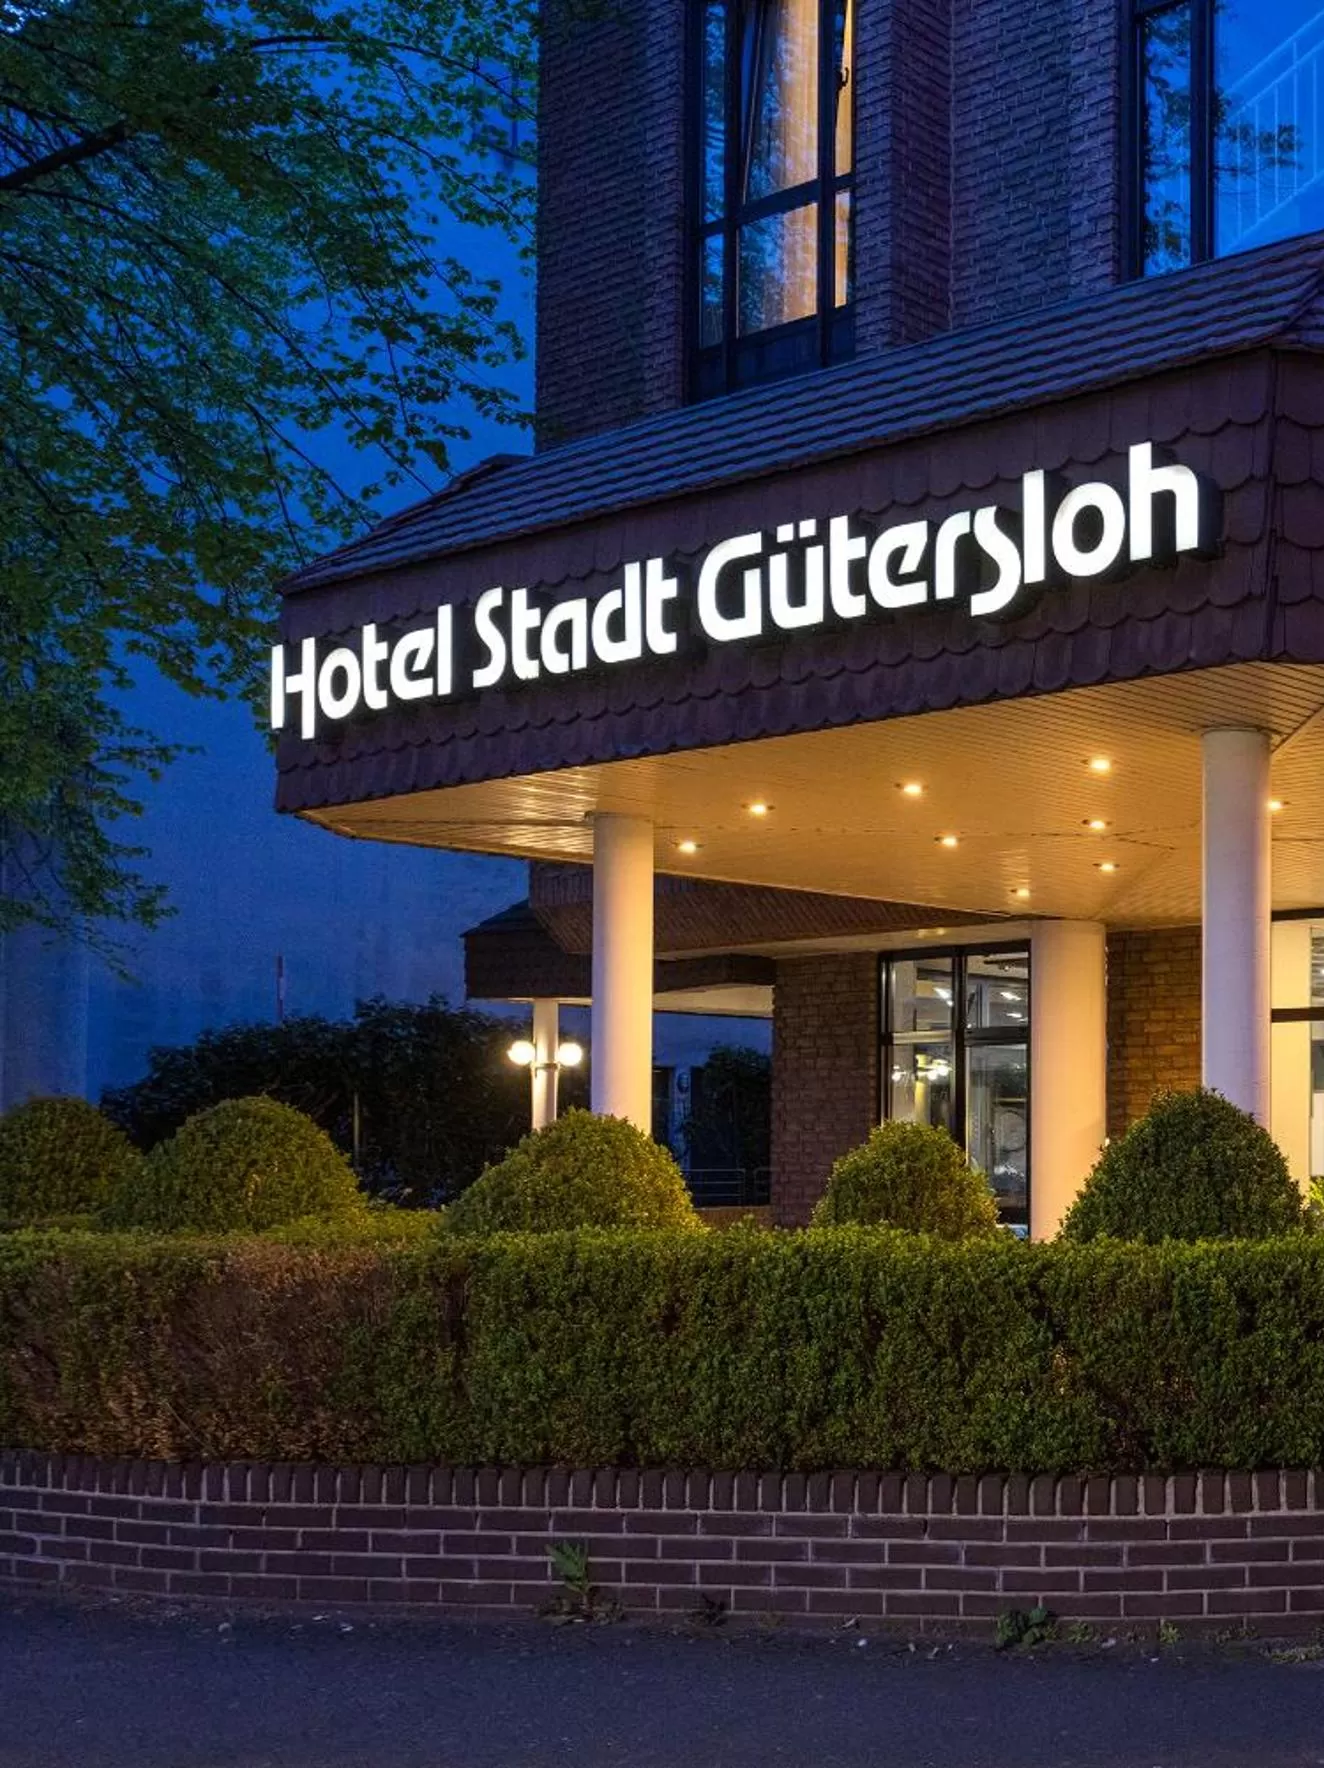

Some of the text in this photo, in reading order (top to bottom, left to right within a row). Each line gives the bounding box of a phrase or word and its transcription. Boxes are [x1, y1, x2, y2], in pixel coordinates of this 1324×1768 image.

[270, 441, 1200, 740] Hotel Stadt Gütersloh
